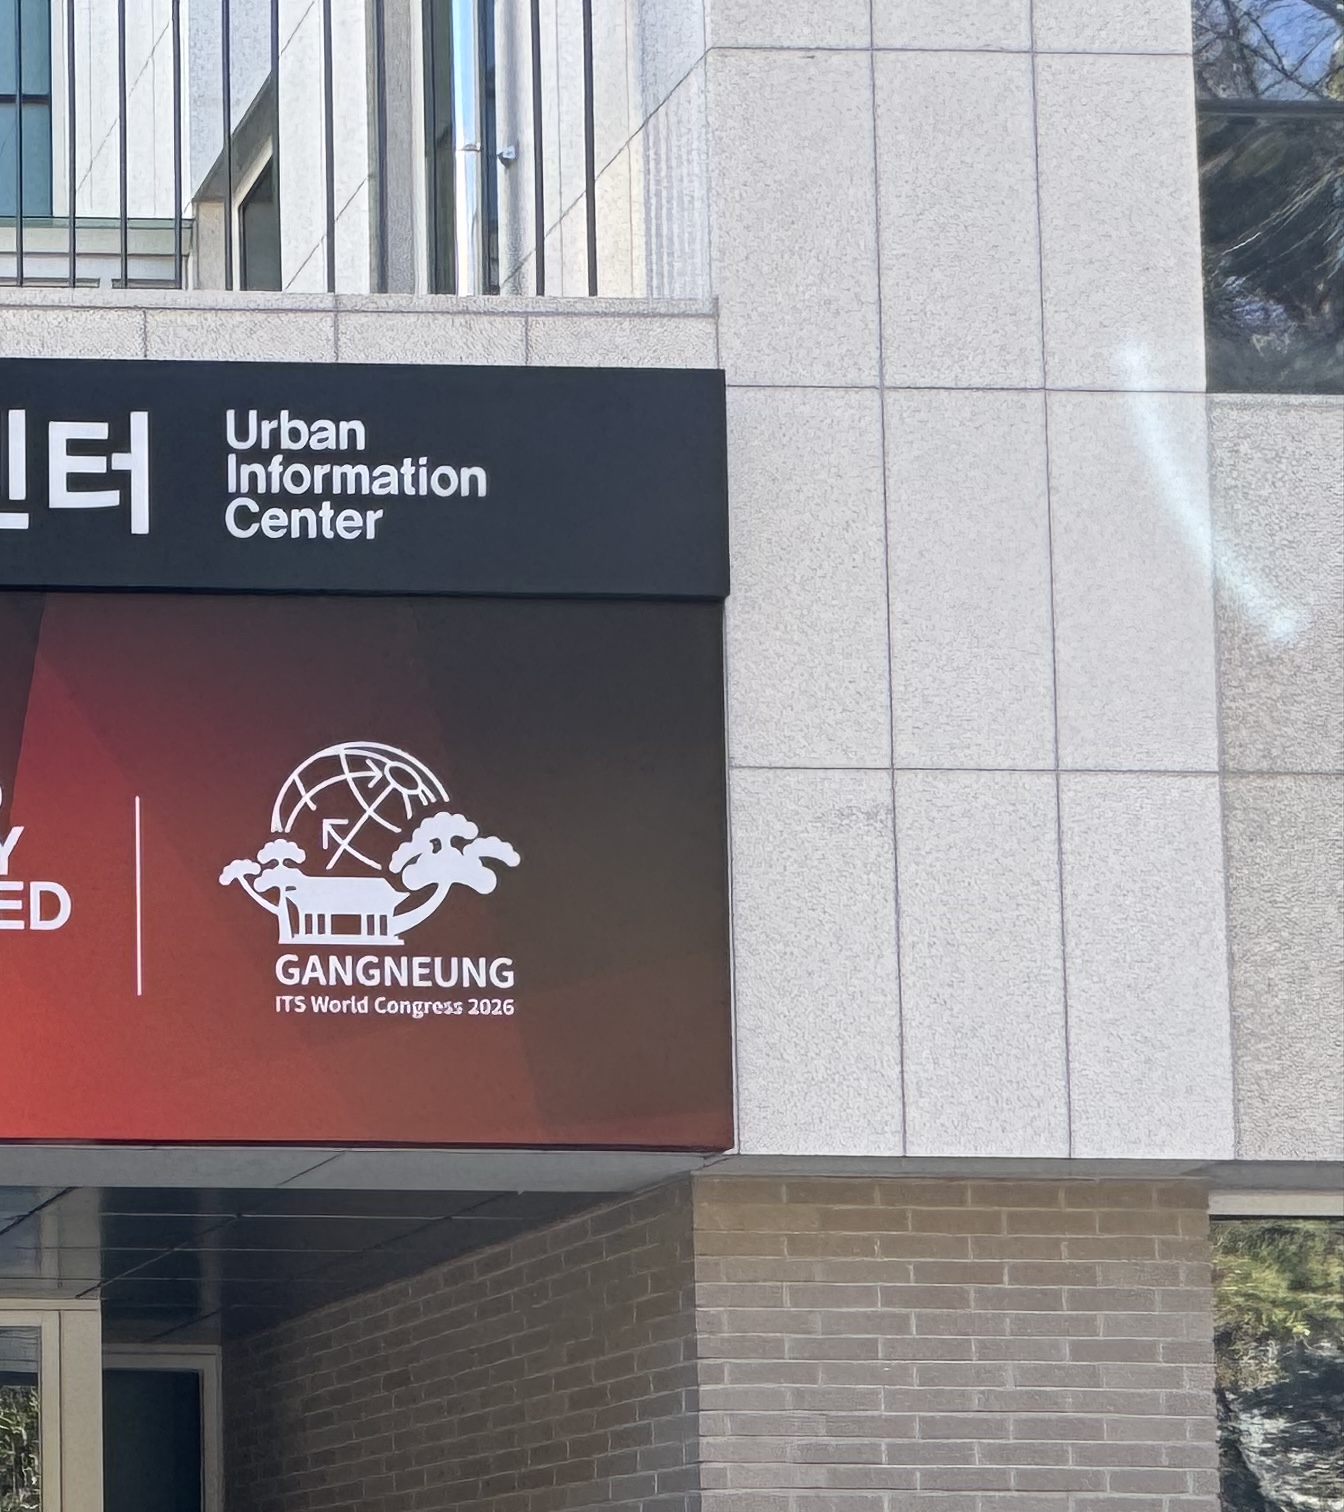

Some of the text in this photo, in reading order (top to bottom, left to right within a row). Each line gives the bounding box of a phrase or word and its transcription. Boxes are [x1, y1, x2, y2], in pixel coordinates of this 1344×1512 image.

[226, 409, 366, 451] Urban
[227, 454, 488, 502] Information
[225, 498, 384, 540] Center
[275, 953, 515, 989] GANGNEUNG
[275, 995, 515, 1020] ITS World Congress 2026
